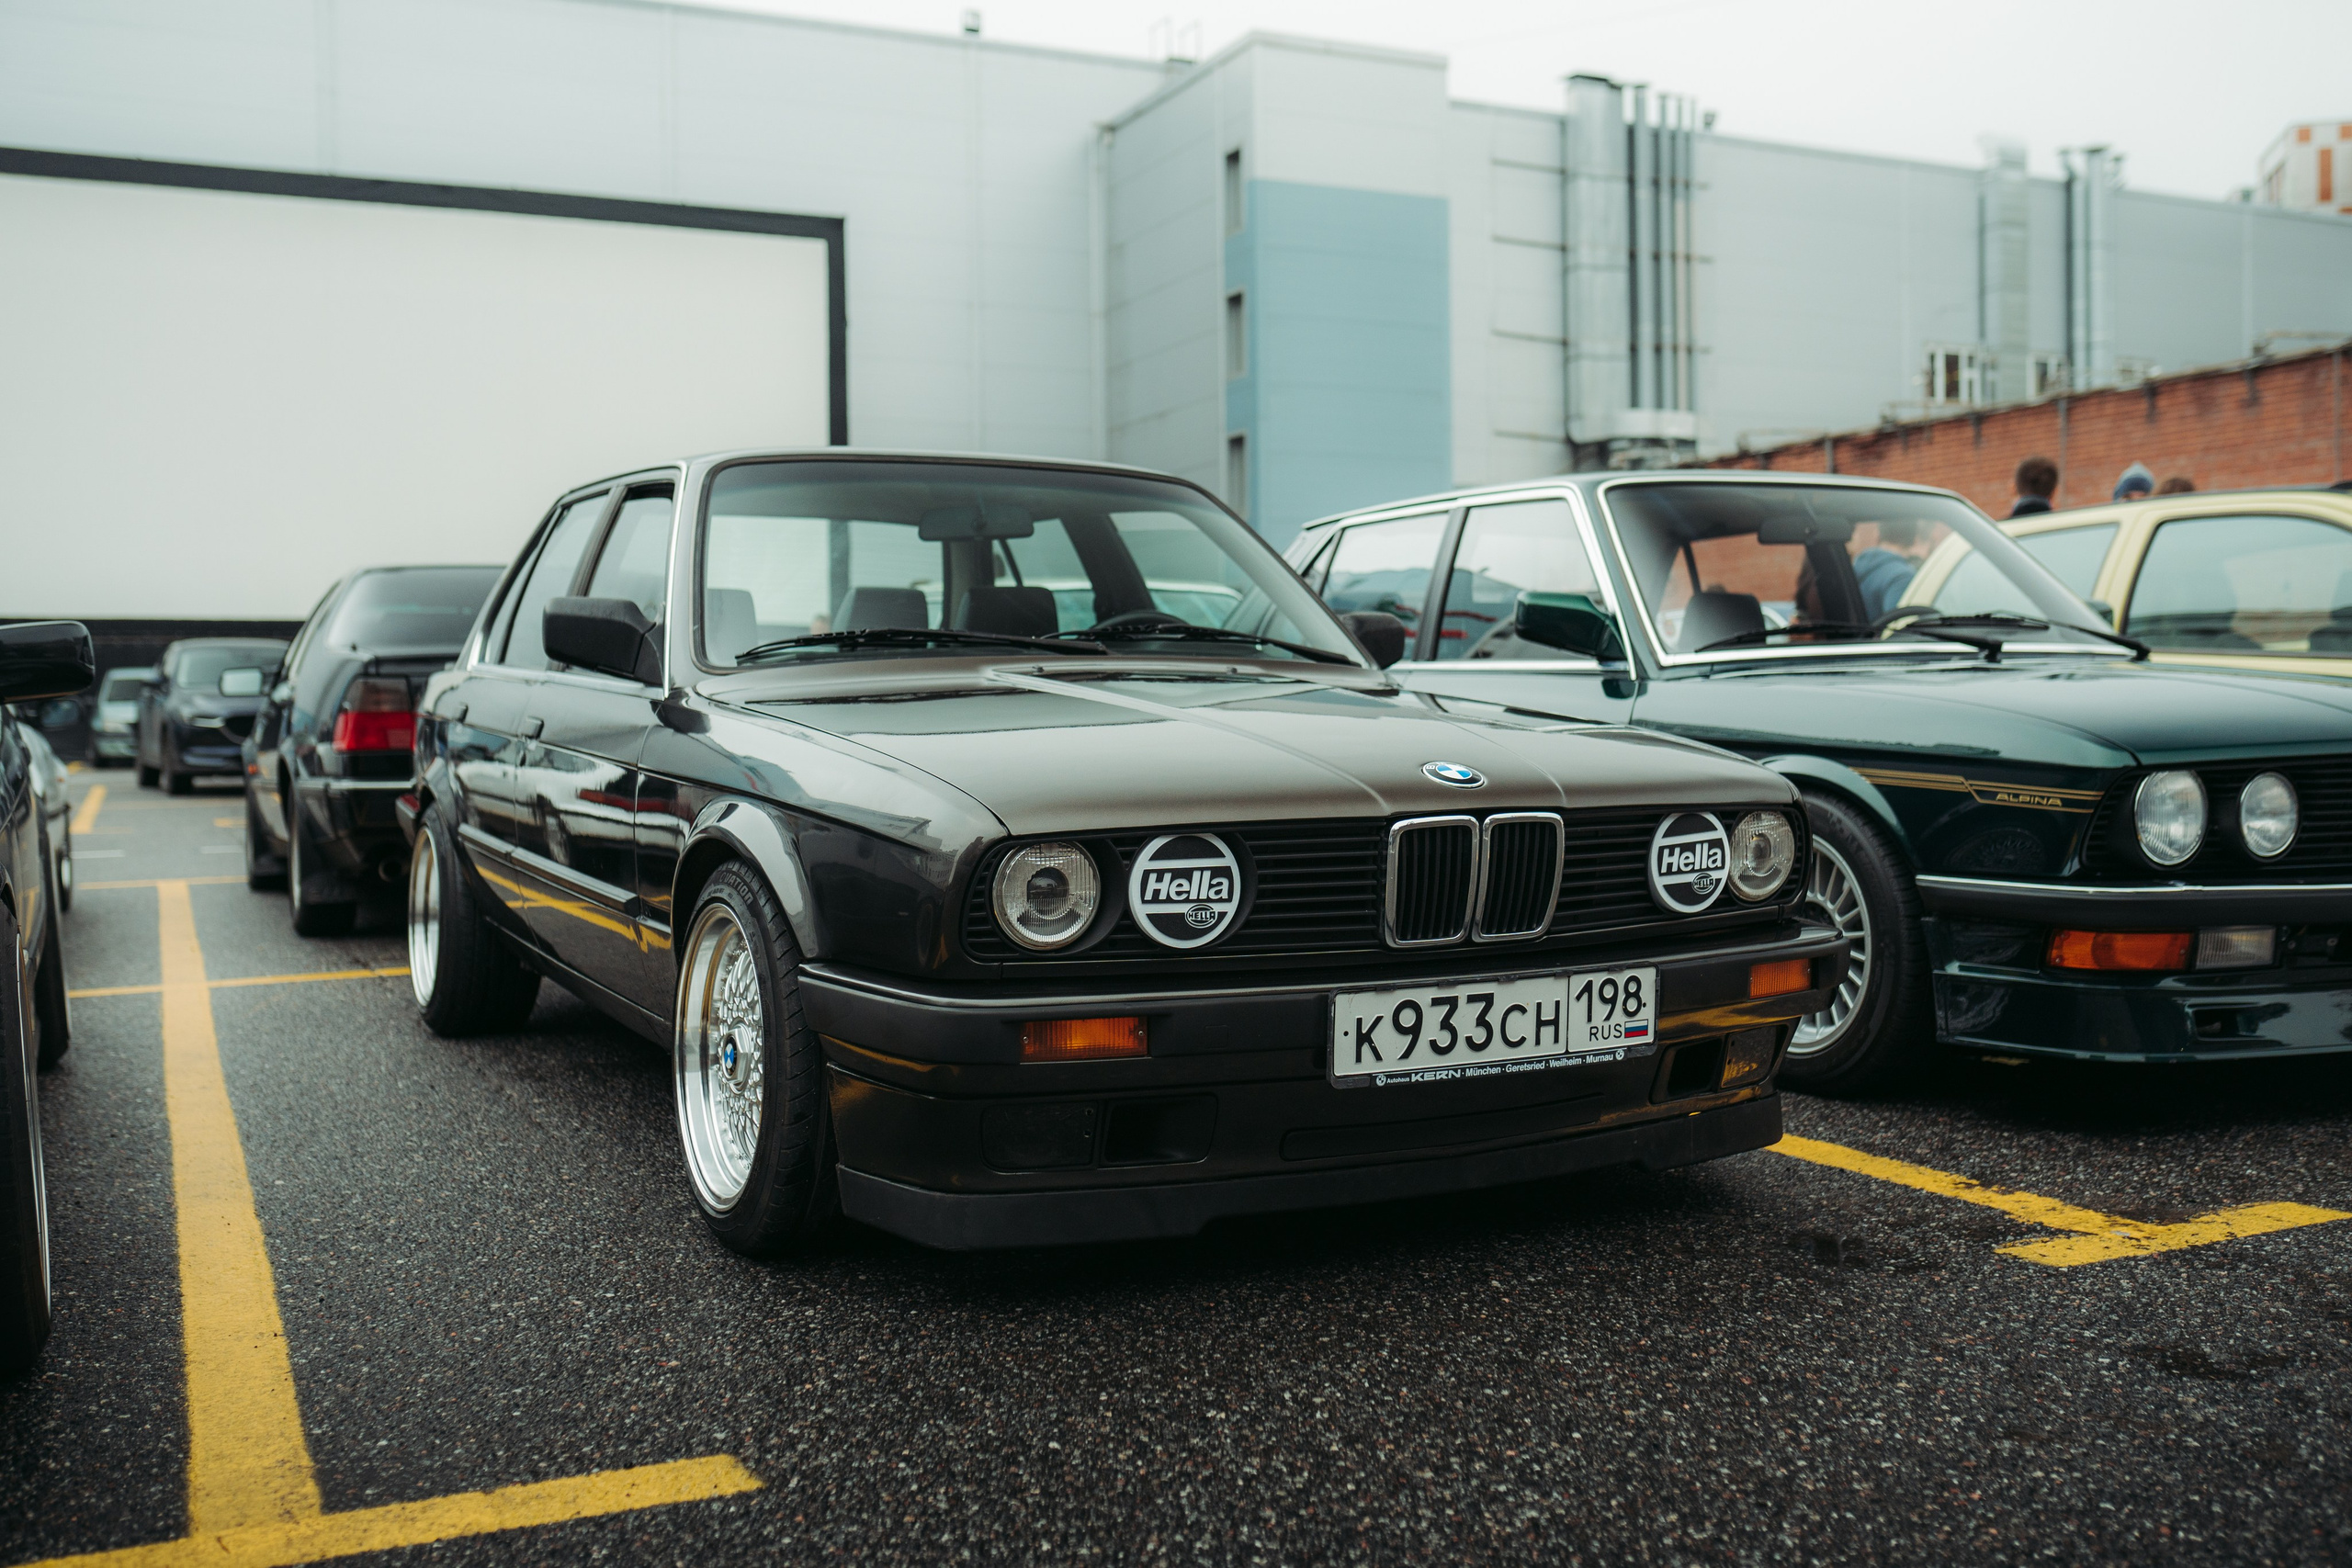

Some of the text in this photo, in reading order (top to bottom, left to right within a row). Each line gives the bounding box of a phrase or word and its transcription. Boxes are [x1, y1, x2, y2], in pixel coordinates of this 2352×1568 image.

[1996, 793, 2063, 807] ALPINA
[1661, 842, 1722, 873] Hella
[1144, 870, 1229, 900] Hella
[1694, 877, 1714, 887] HELLA
[1188, 910, 1216, 919] HELLA
[1574, 975, 1643, 1023] 198
[1589, 1023, 1623, 1042] RUS
[1411, 1069, 1462, 1082] KERN
[1465, 1066, 1501, 1077] München
[1505, 1060, 1545, 1073] Geretsried
[1549, 1056, 1582, 1068] Weilheim
[1586, 1053, 1613, 1064] Murnau
